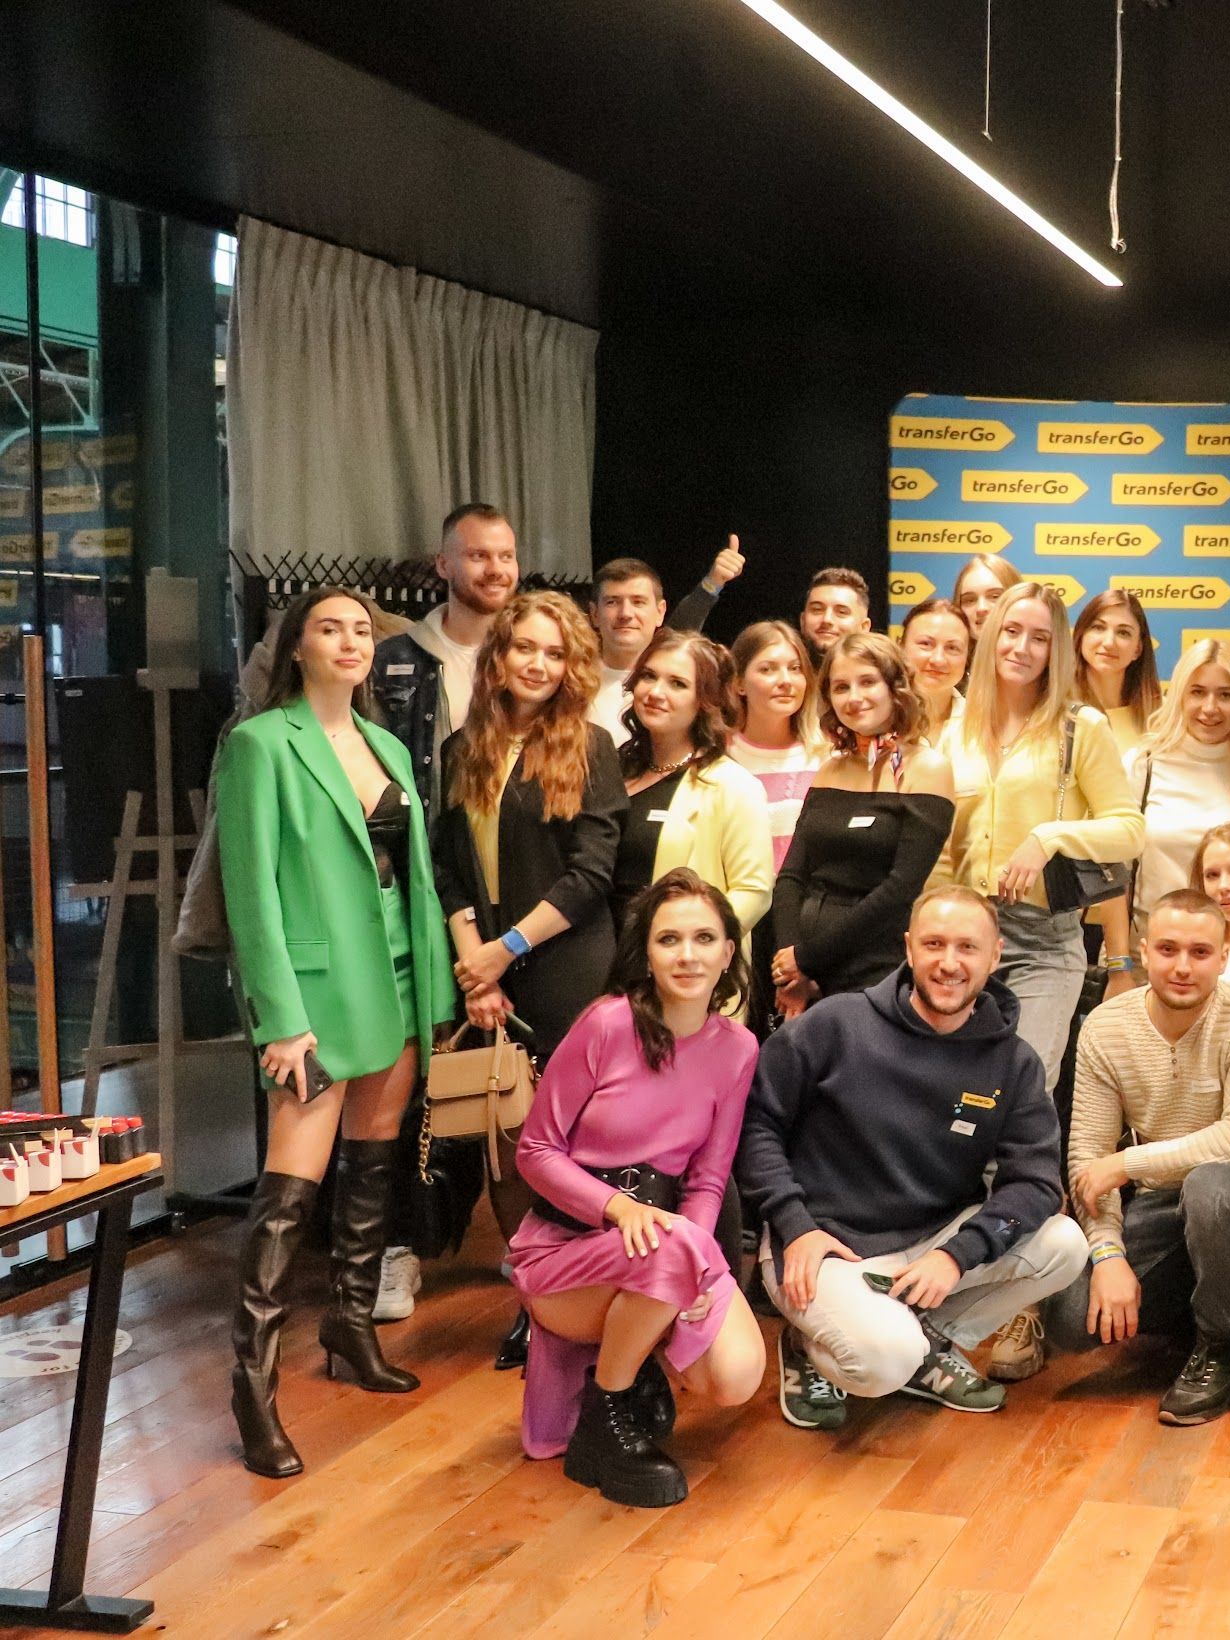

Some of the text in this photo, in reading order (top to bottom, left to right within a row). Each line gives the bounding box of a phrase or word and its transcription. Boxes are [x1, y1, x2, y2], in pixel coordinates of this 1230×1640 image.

[899, 425, 996, 442] transferGo
[1048, 431, 1144, 446] transferGo
[972, 479, 1069, 495] transferGo
[1123, 481, 1218, 497] transferGo
[896, 529, 993, 545] transferGo
[1046, 531, 1142, 547] transferGo
